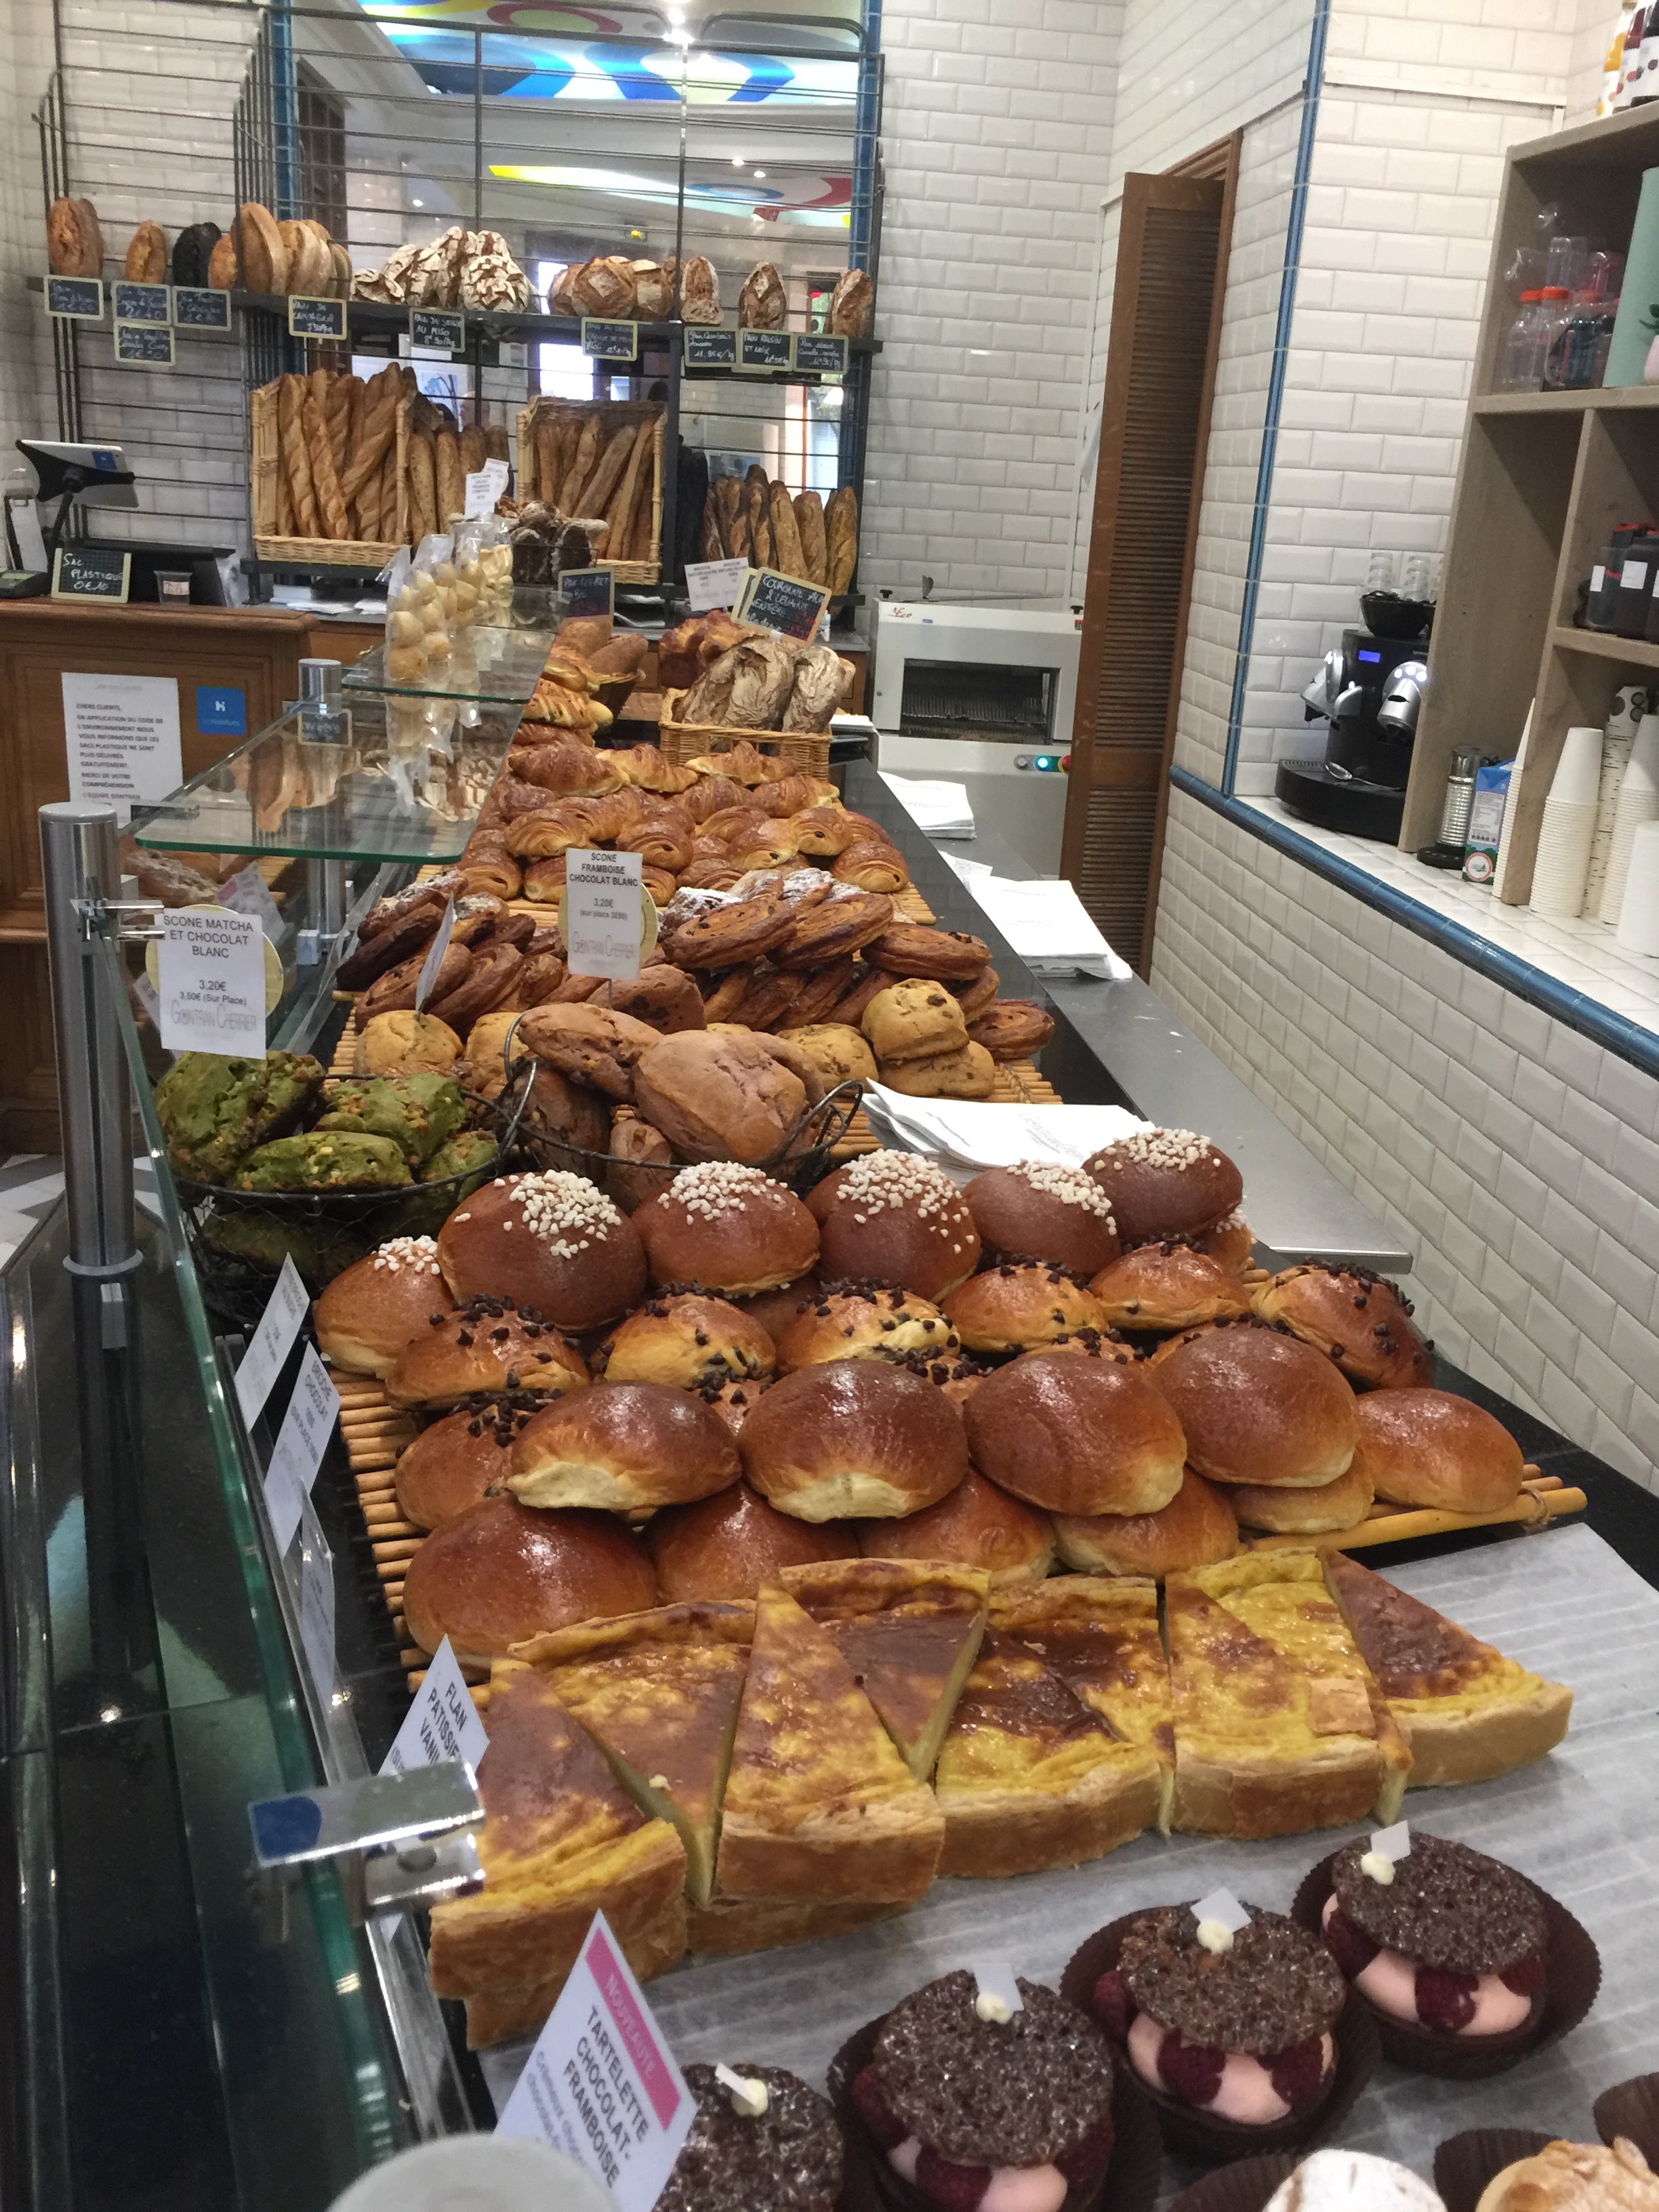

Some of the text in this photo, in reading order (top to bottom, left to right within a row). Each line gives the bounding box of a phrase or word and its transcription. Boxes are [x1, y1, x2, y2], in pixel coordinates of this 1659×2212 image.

[590, 853, 617, 863] SCONE
[581, 863, 626, 875] FRAMBOISE
[569, 874, 638, 887] CHOCOLAT BLANC
[163, 915, 253, 932] SCONE MATCHA
[170, 930, 249, 945] ET CHOCOLAT
[192, 945, 230, 958] BLANC
[199, 980, 227, 991] 3.20€
[203, 994, 220, 1003] (Sur
[222, 994, 247, 1006] Place)
[445, 1681, 468, 1732] FLAN
[428, 1687, 462, 1758] PATISSIE
[587, 2005, 649, 2143] TARTELETTE
[563, 2058, 620, 2189] FRAMBOISE
